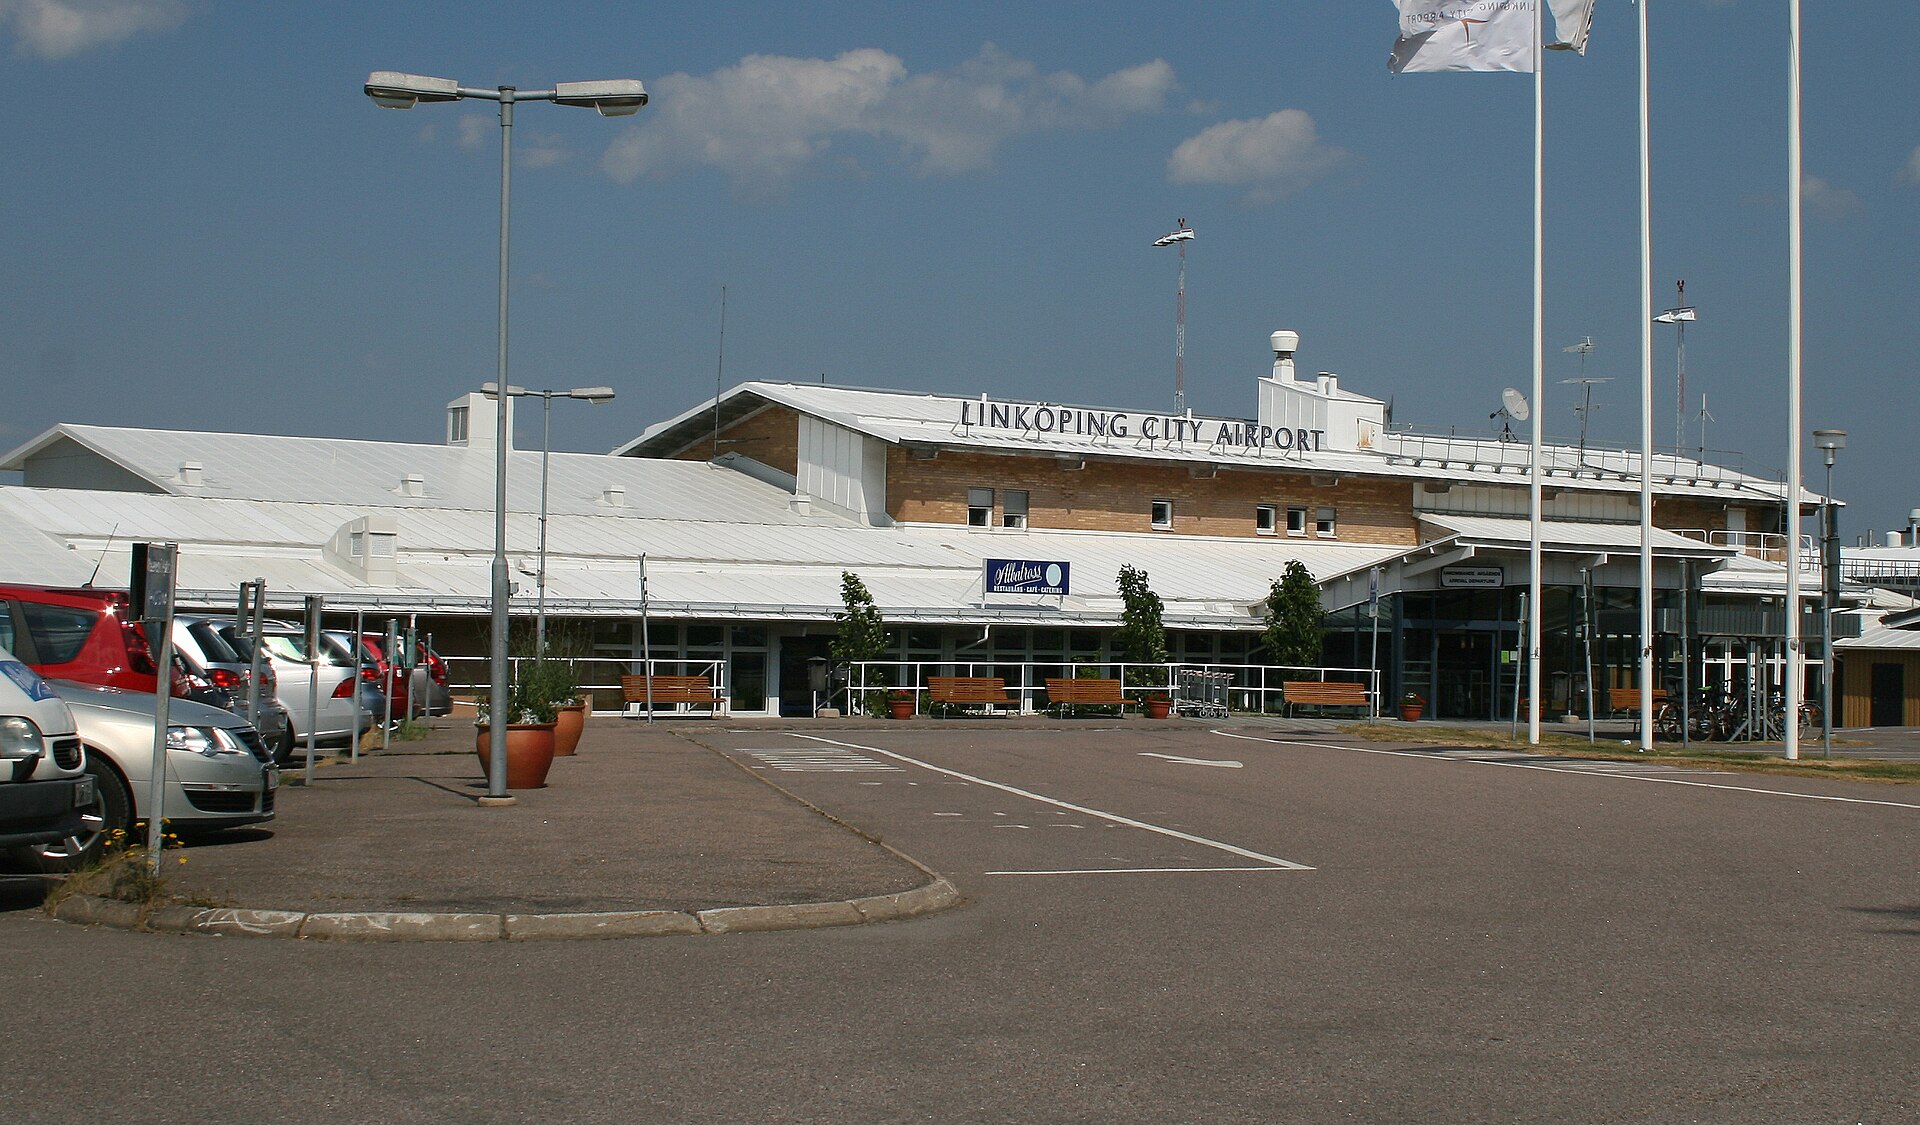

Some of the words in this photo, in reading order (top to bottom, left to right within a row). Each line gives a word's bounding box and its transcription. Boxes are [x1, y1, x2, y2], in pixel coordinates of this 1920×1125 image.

[961, 401, 1128, 438] LINKÖPING
[1142, 416, 1203, 443] CITY
[1216, 422, 1325, 452] AIRPORT
[993, 561, 1043, 586] Albatross
